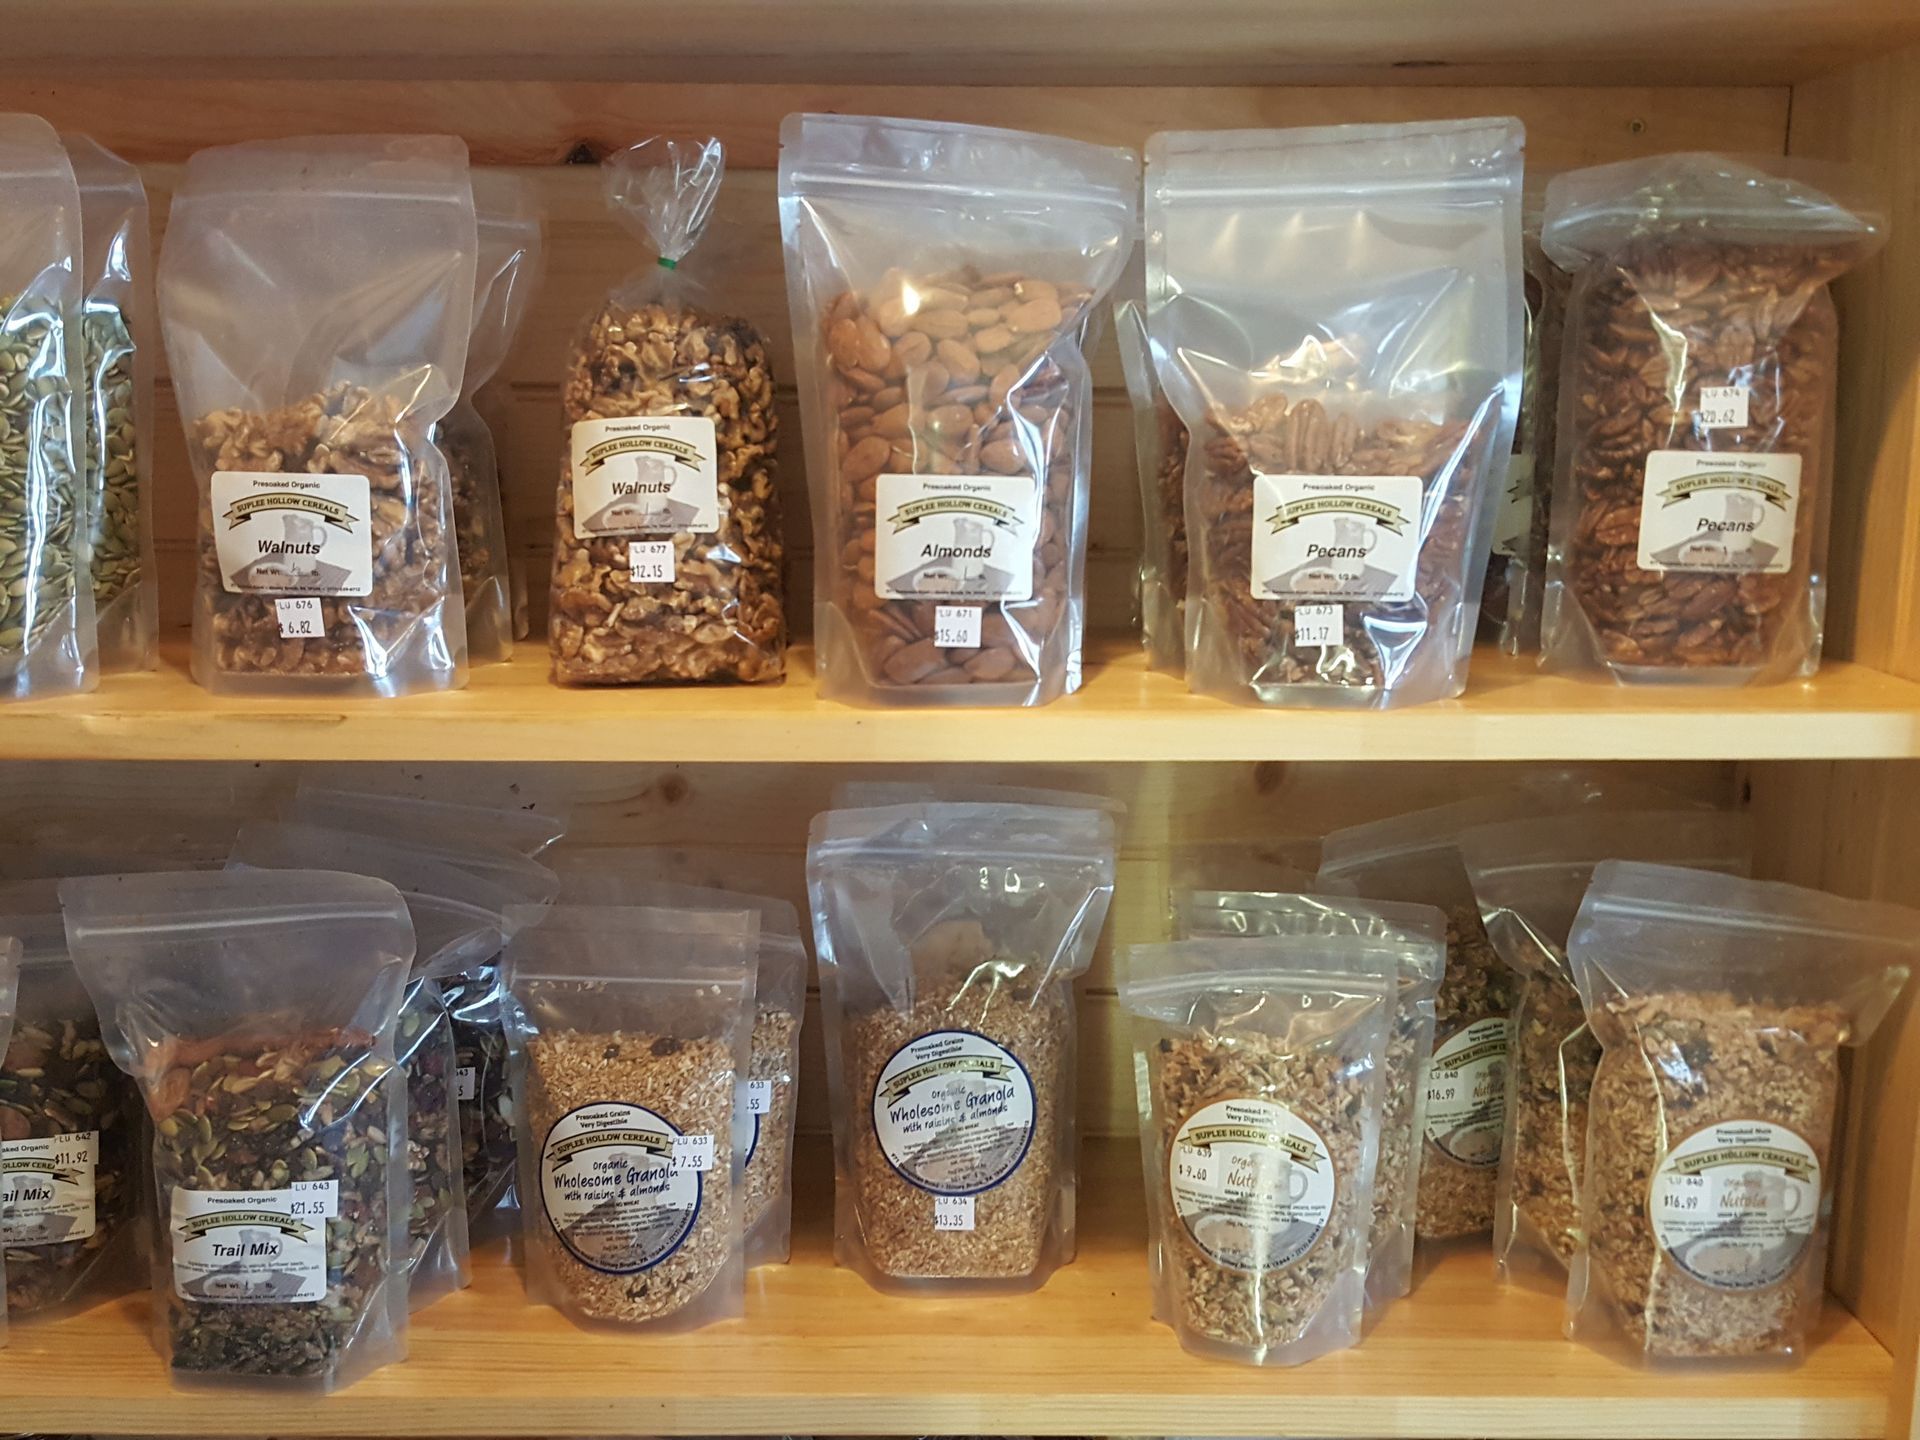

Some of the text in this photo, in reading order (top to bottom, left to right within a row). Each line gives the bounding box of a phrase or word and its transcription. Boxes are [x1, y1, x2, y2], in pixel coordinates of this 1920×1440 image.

[643, 424, 671, 432] Organic
[619, 440, 651, 448] HOLLOW
[654, 441, 688, 454] CEREALS
[253, 480, 320, 489] Presoaked Organic
[612, 481, 671, 495] Walnuts
[923, 483, 991, 492] Presoaked Organic
[1303, 483, 1375, 492] Presoaked Organic
[237, 499, 265, 512] SUPLEE
[302, 500, 339, 514] CEREALS
[905, 502, 935, 515] SUPLEE
[937, 501, 971, 509] HOLLOW
[1318, 501, 1353, 509] HOLLOW
[1355, 502, 1392, 517] CEREALS
[1697, 518, 1755, 532] Pecans
[258, 540, 320, 554] Walnuts
[651, 545, 666, 554] 677
[921, 544, 991, 558] Almonds
[1306, 544, 1366, 557] Pecans
[631, 565, 663, 578] $12.15
[296, 601, 312, 609] 676
[1316, 607, 1333, 615] 673
[1296, 628, 1329, 640] $11.17
[944, 1038, 964, 1046] Grains
[916, 1052, 930, 1060] Very
[1444, 1052, 1472, 1068] SUPLEE
[893, 1072, 921, 1088] SUPLEE
[1428, 1089, 1455, 1100] $16.99
[890, 1084, 1014, 1124] Wholesome Granola
[1226, 1106, 1262, 1115] Presoaked
[576, 1110, 630, 1121] Presoaked Grains
[903, 1122, 921, 1134] with
[971, 1103, 1008, 1120] almonds
[1226, 1114, 1241, 1122] Very
[580, 1118, 628, 1129] Very Digestible
[1195, 1130, 1228, 1140] SUPLEE
[1229, 1128, 1266, 1139] HOLLOW
[557, 1134, 660, 1153] SUPLEE HOLLOW CEREALS
[55, 1151, 88, 1164] $11.92
[1684, 1151, 1800, 1168] SUPLEE HOLLOW CEREALS
[313, 1182, 330, 1190] 643
[554, 1172, 621, 1189] Wholesome
[23, 1188, 50, 1200] Mix
[564, 1182, 670, 1200] with raisins & almonds
[247, 1197, 278, 1205] Organic
[1664, 1195, 1698, 1209] $16.99
[291, 1202, 324, 1214] $21.55
[192, 1214, 295, 1228] SUPLEE HOLLOW CEREALS
[934, 1215, 963, 1226] $13.35
[213, 1242, 278, 1256] Trail Mix
